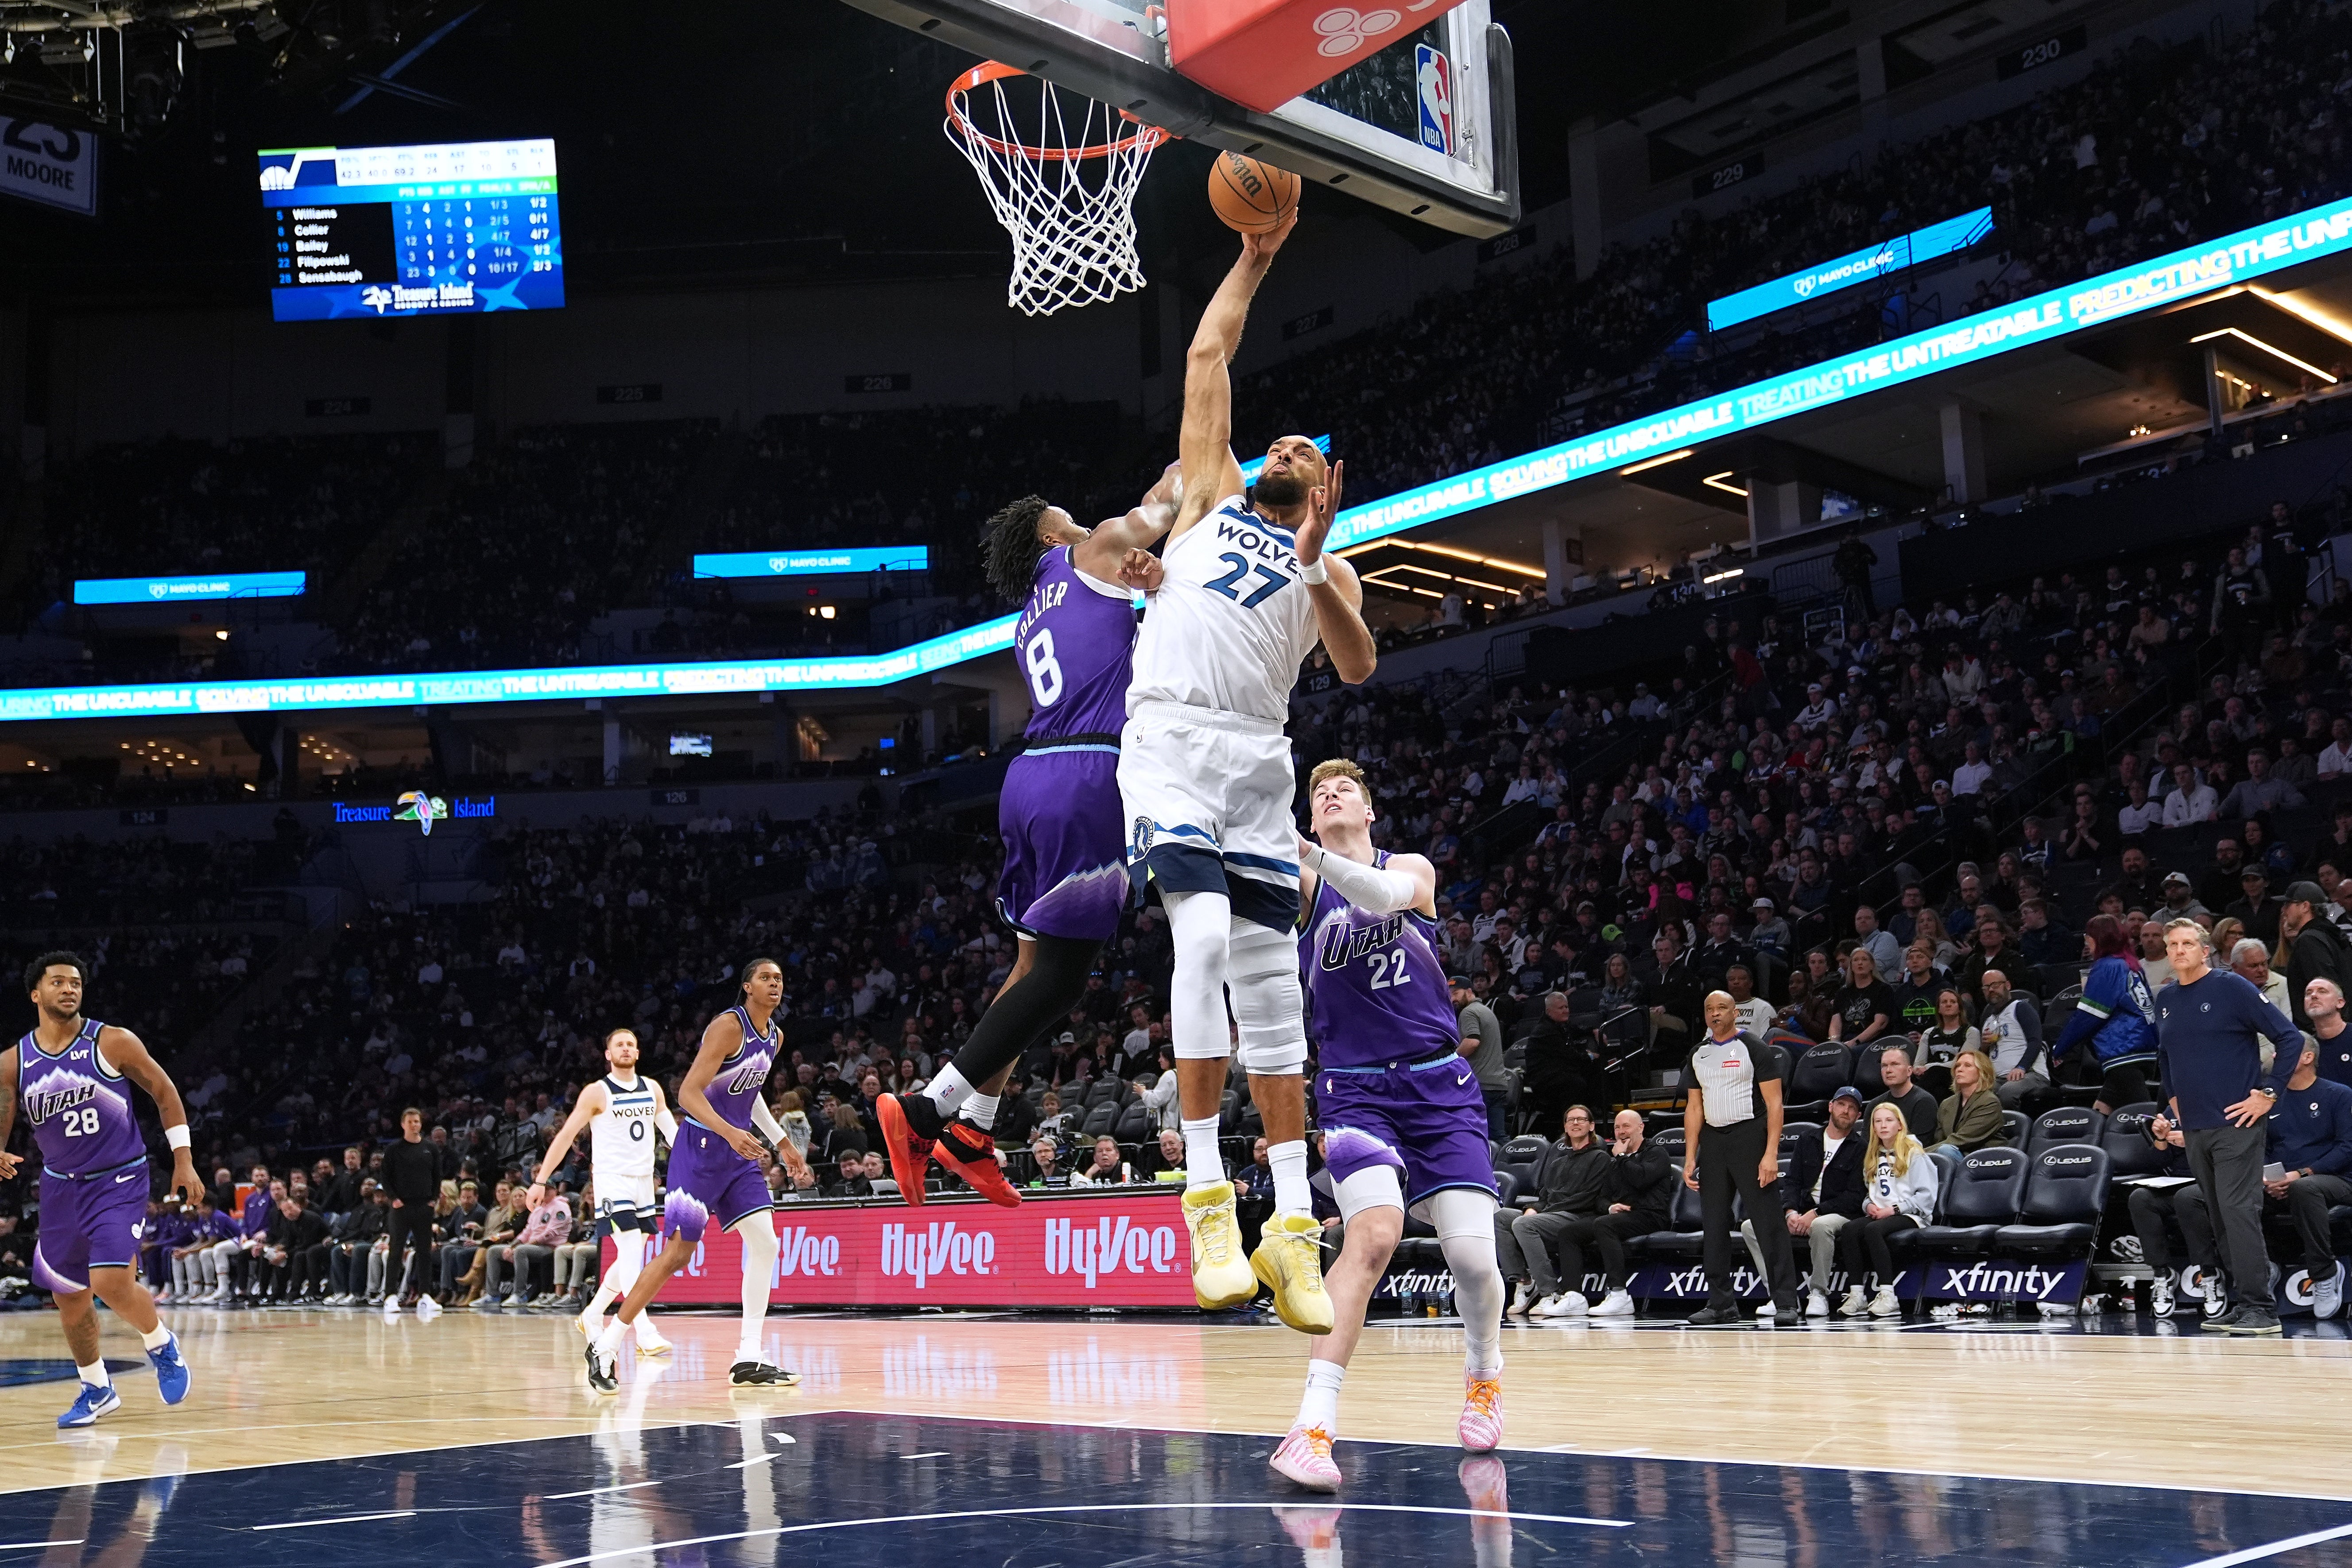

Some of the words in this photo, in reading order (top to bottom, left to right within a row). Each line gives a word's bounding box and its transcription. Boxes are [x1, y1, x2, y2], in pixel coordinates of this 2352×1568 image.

[2022, 39, 2061, 68] 230
[1424, 126, 1441, 148] NBA
[7, 155, 75, 192] MOORE
[454, 165, 464, 173] 17
[511, 162, 517, 170] 5
[1713, 163, 1743, 189] 229
[292, 208, 338, 221] Williams
[422, 201, 431, 214] 4
[444, 201, 451, 213] 2
[465, 200, 471, 212] 1
[490, 199, 508, 210] 1/3
[530, 196, 547, 209] 1/2
[294, 224, 329, 236] Collier
[425, 217, 432, 230] 1
[465, 216, 473, 228] 0
[529, 212, 548, 225] 0/1
[295, 240, 329, 253] Bailey
[405, 235, 418, 247] 12
[426, 233, 433, 245] 1
[446, 232, 454, 244] 2
[466, 232, 474, 244] 3
[491, 229, 510, 242] 4/7
[530, 227, 550, 240] 4/7
[1494, 234, 1519, 256] 228
[297, 253, 350, 269] Filipowski
[427, 248, 434, 261] 1
[467, 247, 476, 259] 0
[493, 246, 512, 258] 1/4
[534, 243, 550, 256] 1/2
[1818, 267, 1850, 286] MAYO
[1851, 250, 1895, 275] CLINIC
[299, 269, 363, 284] Sensabaugh
[407, 266, 420, 278] 23
[427, 264, 436, 277] 3
[468, 263, 477, 275] 0
[488, 260, 519, 274] 10/17
[533, 259, 552, 272] 2/3
[2069, 249, 2232, 318] PREDICTING
[2229, 229, 2293, 268] THE
[391, 284, 438, 302] Treasure
[439, 280, 474, 300] Island
[1296, 314, 1318, 333] 227
[1737, 369, 1844, 418] TREATING
[1842, 354, 1892, 387] THE
[1891, 300, 2063, 372] UNTREATABLE
[615, 387, 643, 401] 225
[864, 376, 892, 391] 226
[324, 401, 352, 414] 224
[1488, 454, 1568, 493] SOLVING
[1566, 440, 1607, 470] THE
[1606, 401, 1734, 458] UNSOLVABLE
[1350, 509, 1385, 535] THE
[1385, 477, 1486, 524] UNCURABLE
[790, 557, 817, 568] MAYO
[818, 556, 851, 566] CLINIC
[1217, 522, 1301, 578] WOLVE
[1202, 552, 1291, 609] 27
[1018, 581, 1068, 650] COLLIER
[920, 640, 961, 665] SEEING
[960, 631, 984, 653] THE
[664, 667, 766, 686] PREDICTING
[764, 666, 800, 683] THE
[1026, 627, 1063, 708] 8
[195, 686, 271, 708] SOLVING
[269, 685, 305, 703] THE
[306, 681, 415, 702] UNSOLVABLE
[419, 678, 503, 698] TREATING
[502, 676, 537, 694] THE
[538, 670, 659, 692] UNTREATABLE
[1309, 675, 1330, 692] 129
[0, 696, 52, 712] URING
[52, 693, 89, 712] THE
[89, 689, 192, 711] UNCURABLE
[332, 802, 391, 823] Treasure
[453, 796, 495, 818] Island
[1321, 912, 1404, 972] UTAH
[1368, 948, 1412, 990] 22
[70, 1049, 89, 1061] LVT
[728, 1067, 769, 1096] UTA
[27, 1084, 97, 1126] UTAH
[612, 1107, 654, 1119] WOLVES
[62, 1107, 101, 1137] 28
[630, 1120, 644, 1142] 0
[1979, 1159, 2012, 1167] LEXUS
[2057, 1157, 2092, 1165] LEXUS
[1880, 1179, 1891, 1196] 5
[881, 1222, 995, 1289] HyVee
[1045, 1216, 1176, 1289] HyVee
[1941, 1261, 2065, 1299] xfinity
